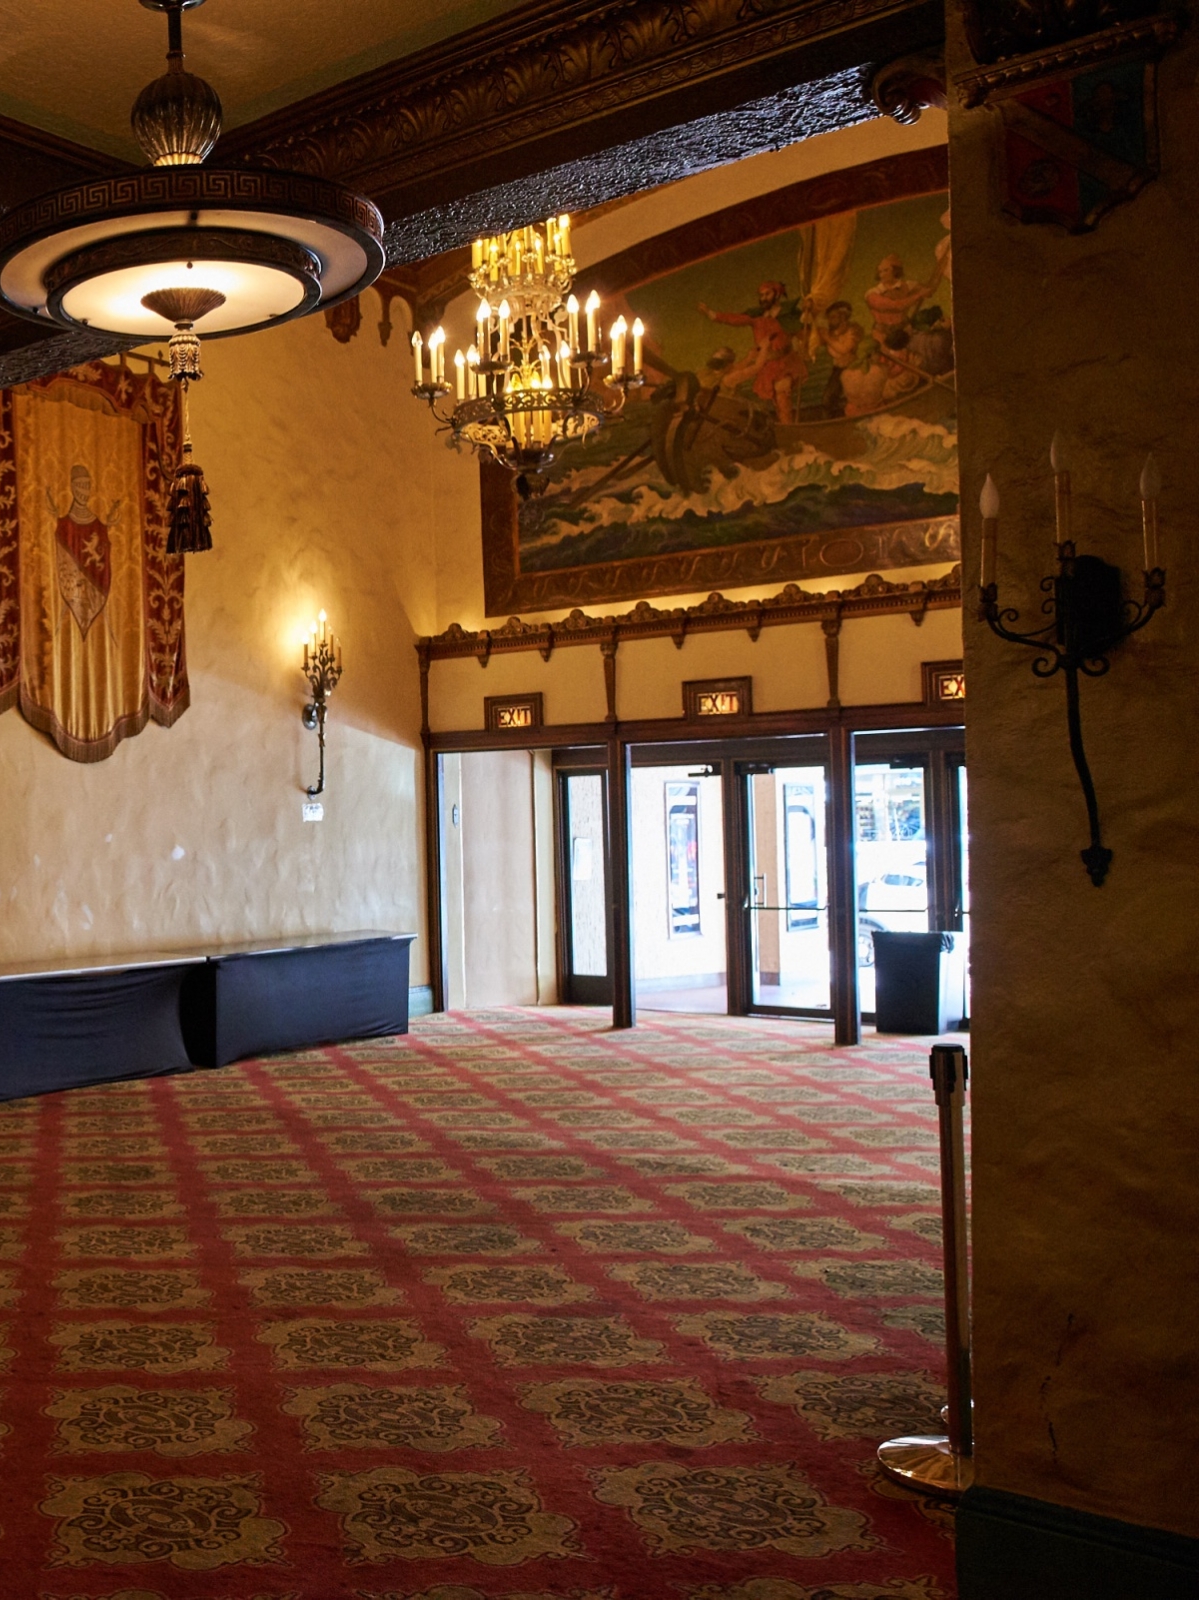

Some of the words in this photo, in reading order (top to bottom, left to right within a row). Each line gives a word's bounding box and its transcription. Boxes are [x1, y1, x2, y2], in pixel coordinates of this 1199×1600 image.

[940, 677, 965, 697] EX
[698, 694, 737, 713] EXIT
[498, 708, 530, 726] EXIT
